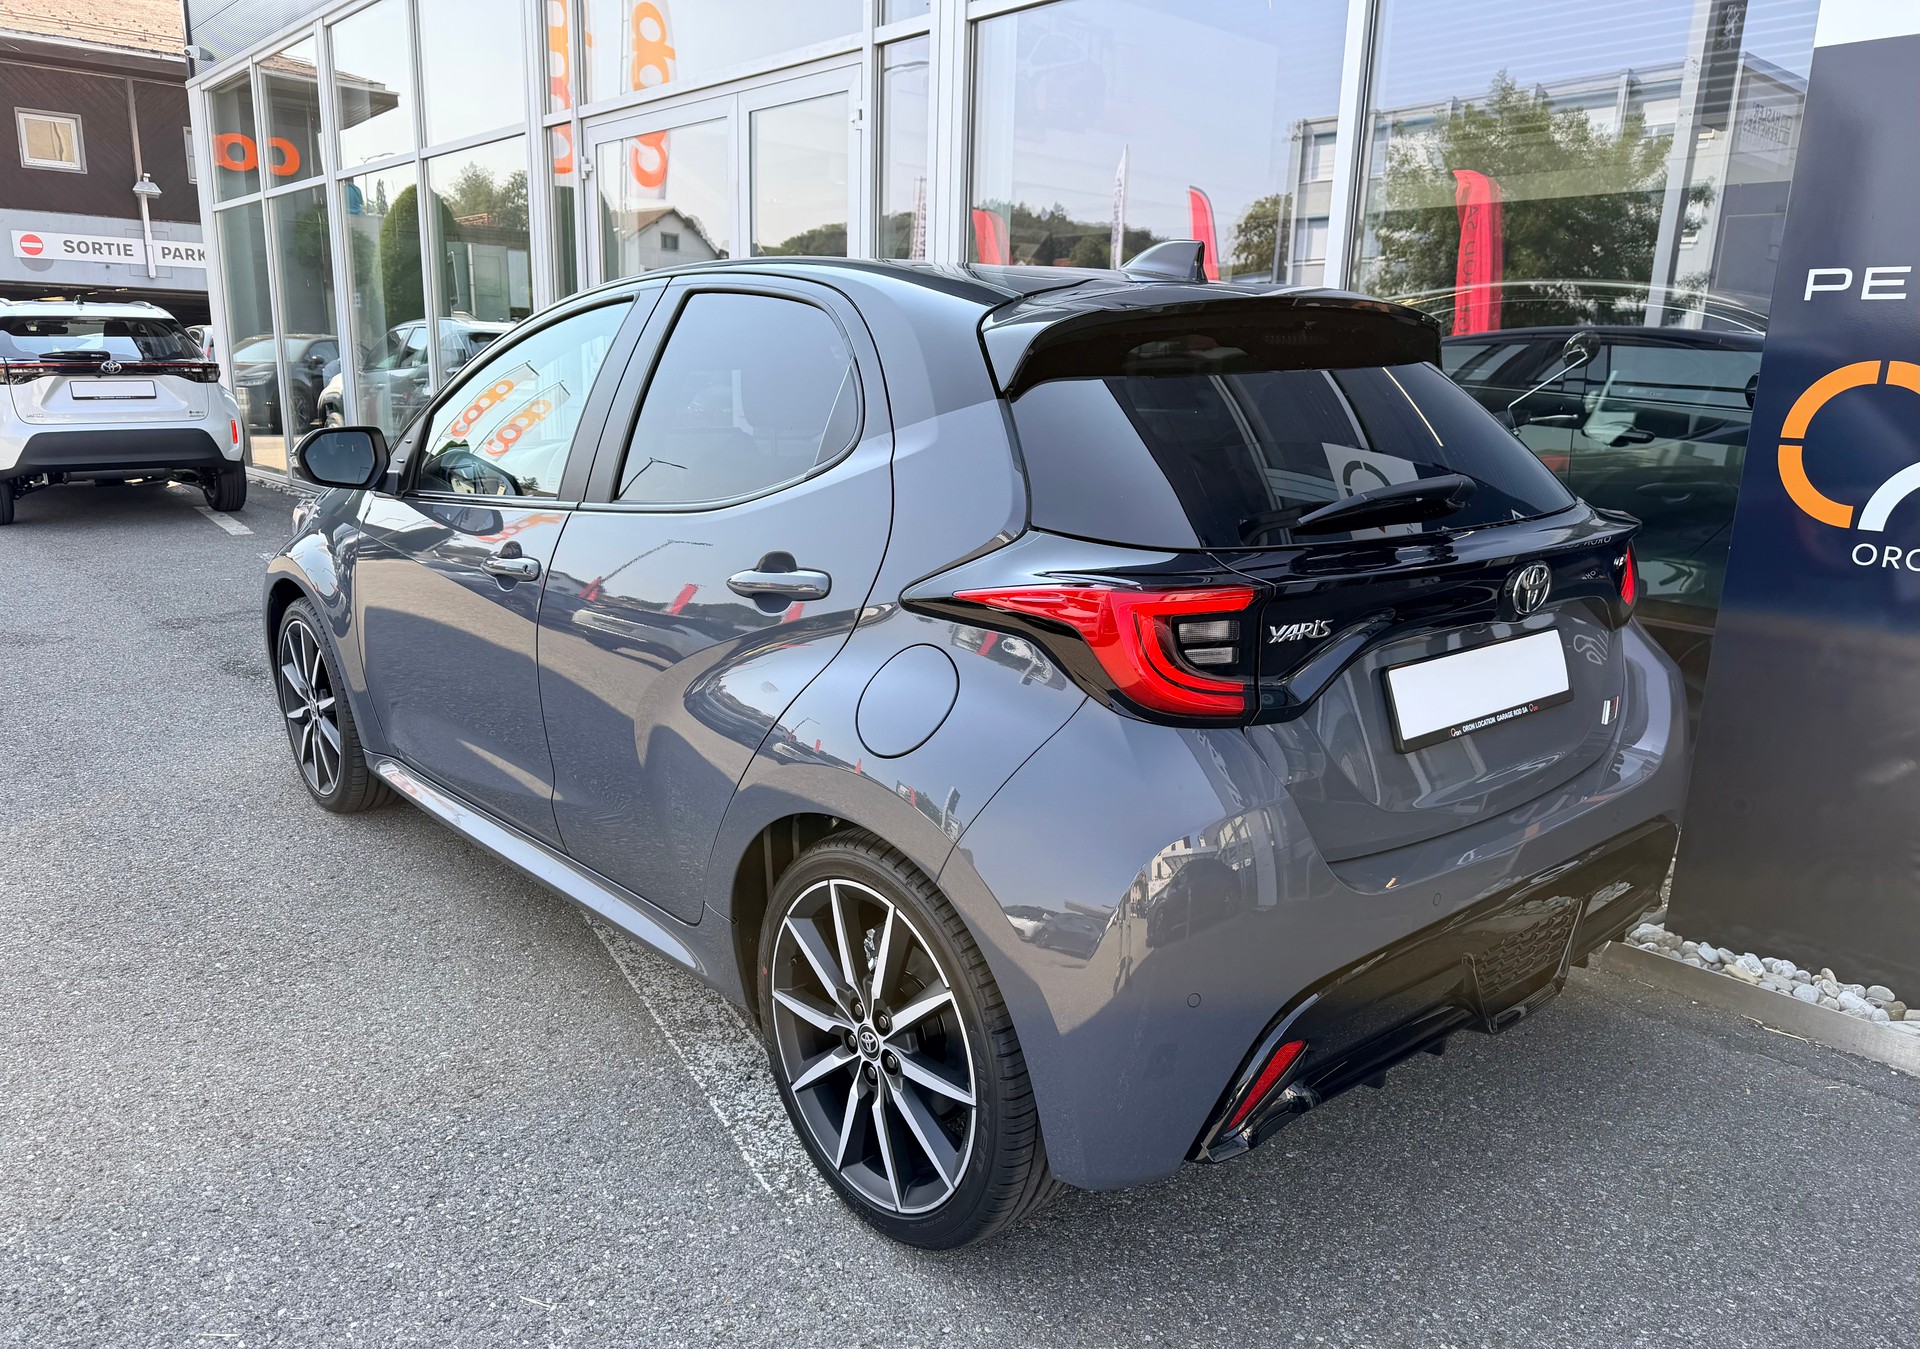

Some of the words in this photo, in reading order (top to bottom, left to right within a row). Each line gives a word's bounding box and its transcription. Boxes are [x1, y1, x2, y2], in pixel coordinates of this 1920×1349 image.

[62, 239, 134, 257] SORTIE
[1803, 266, 1912, 301] PE
[450, 380, 515, 437] coop
[485, 399, 552, 457] coop
[1267, 619, 1334, 644] YARIS
[1462, 723, 1475, 733] ORON
[1476, 717, 1496, 728] LOCATION
[1496, 711, 1513, 722] GARAGE
